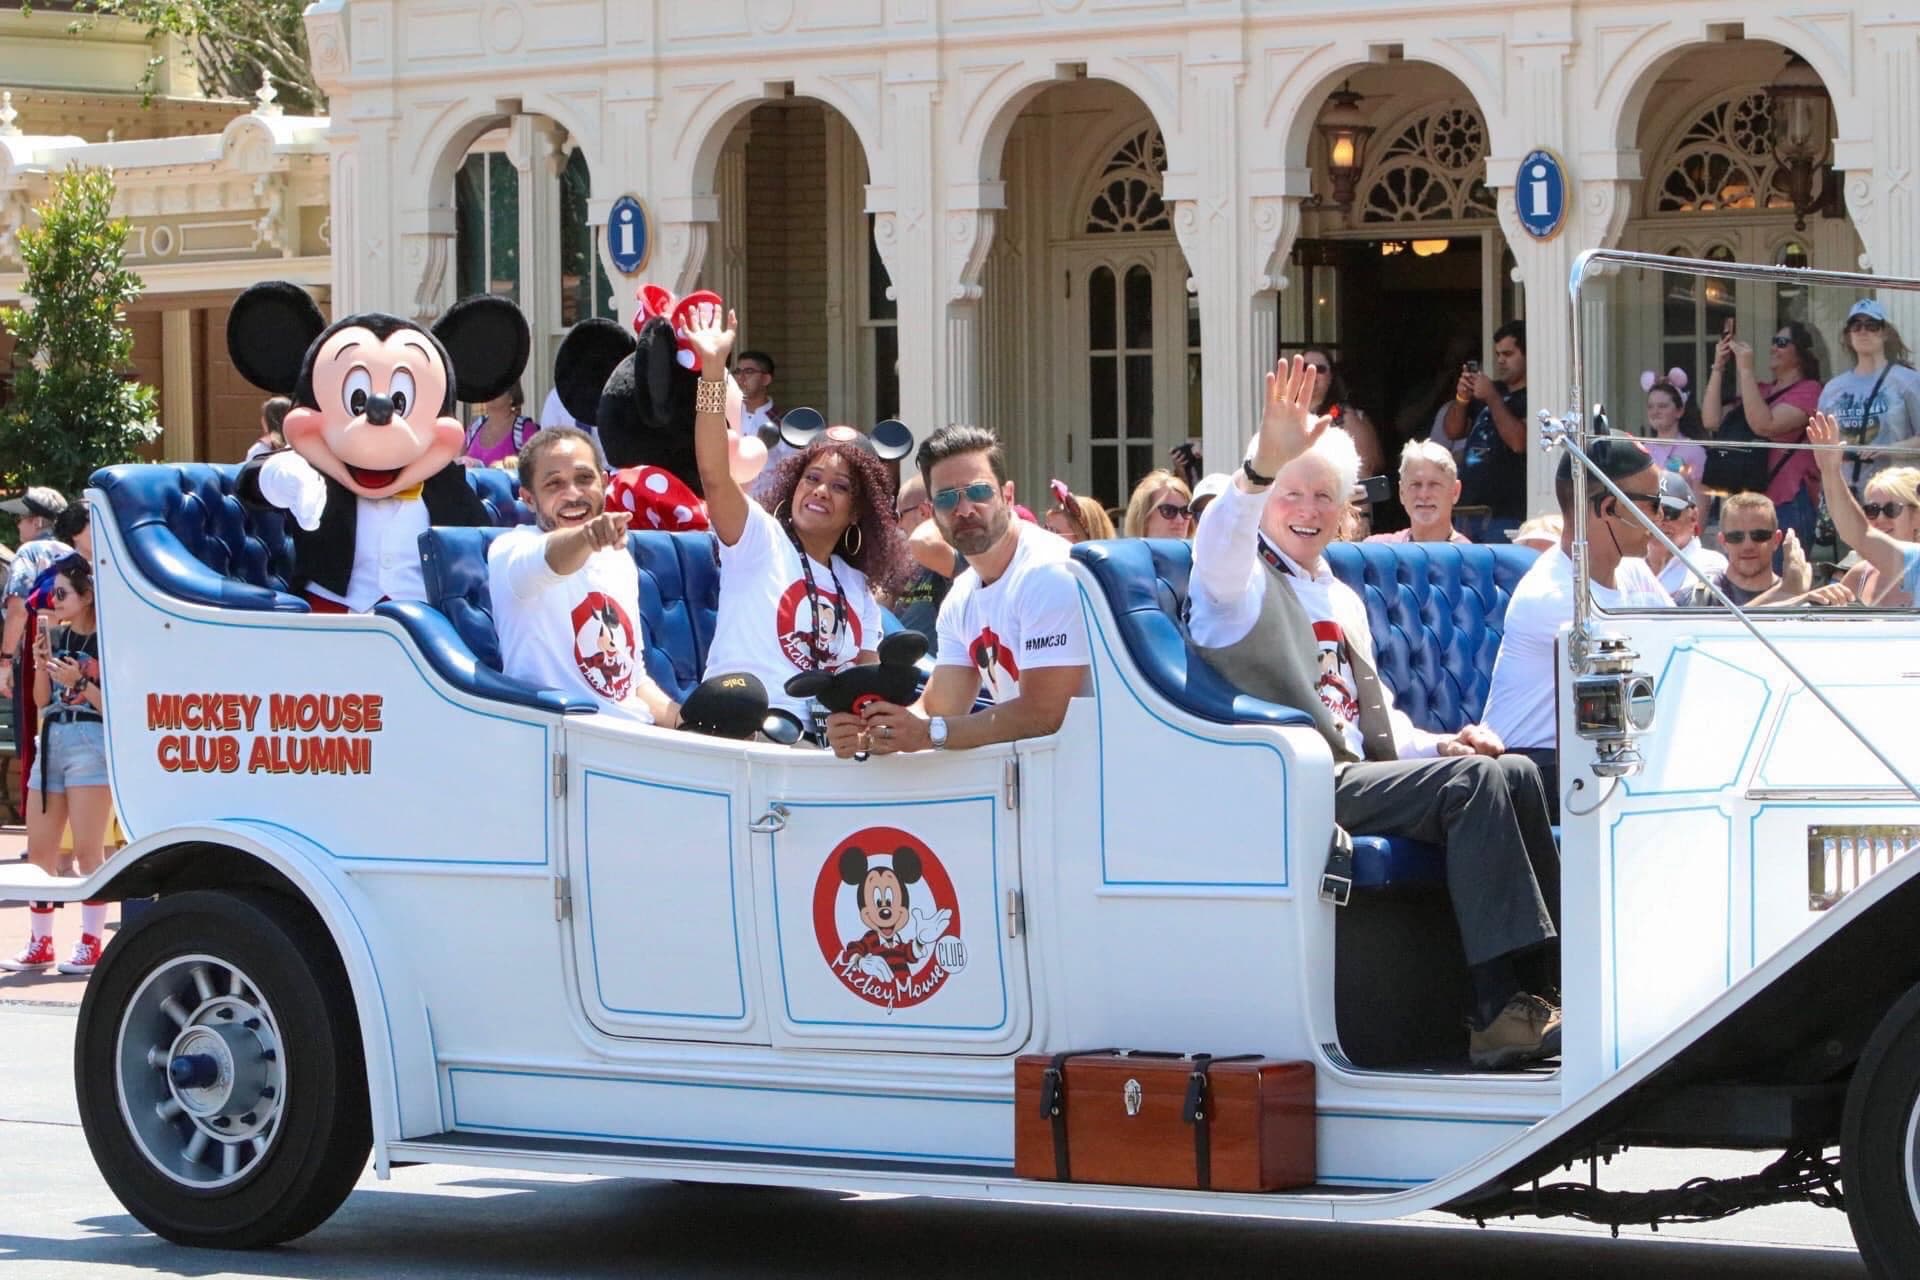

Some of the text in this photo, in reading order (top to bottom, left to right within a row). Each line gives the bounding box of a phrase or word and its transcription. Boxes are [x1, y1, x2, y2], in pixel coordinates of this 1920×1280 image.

[1025, 633, 1067, 651] #MMC30
[721, 678, 747, 688] Dale
[146, 693, 383, 732] MICKEY MOUSE
[157, 735, 371, 775] CLUB ALUMNI
[831, 942, 965, 1015] Mickey Mouse CLUB
